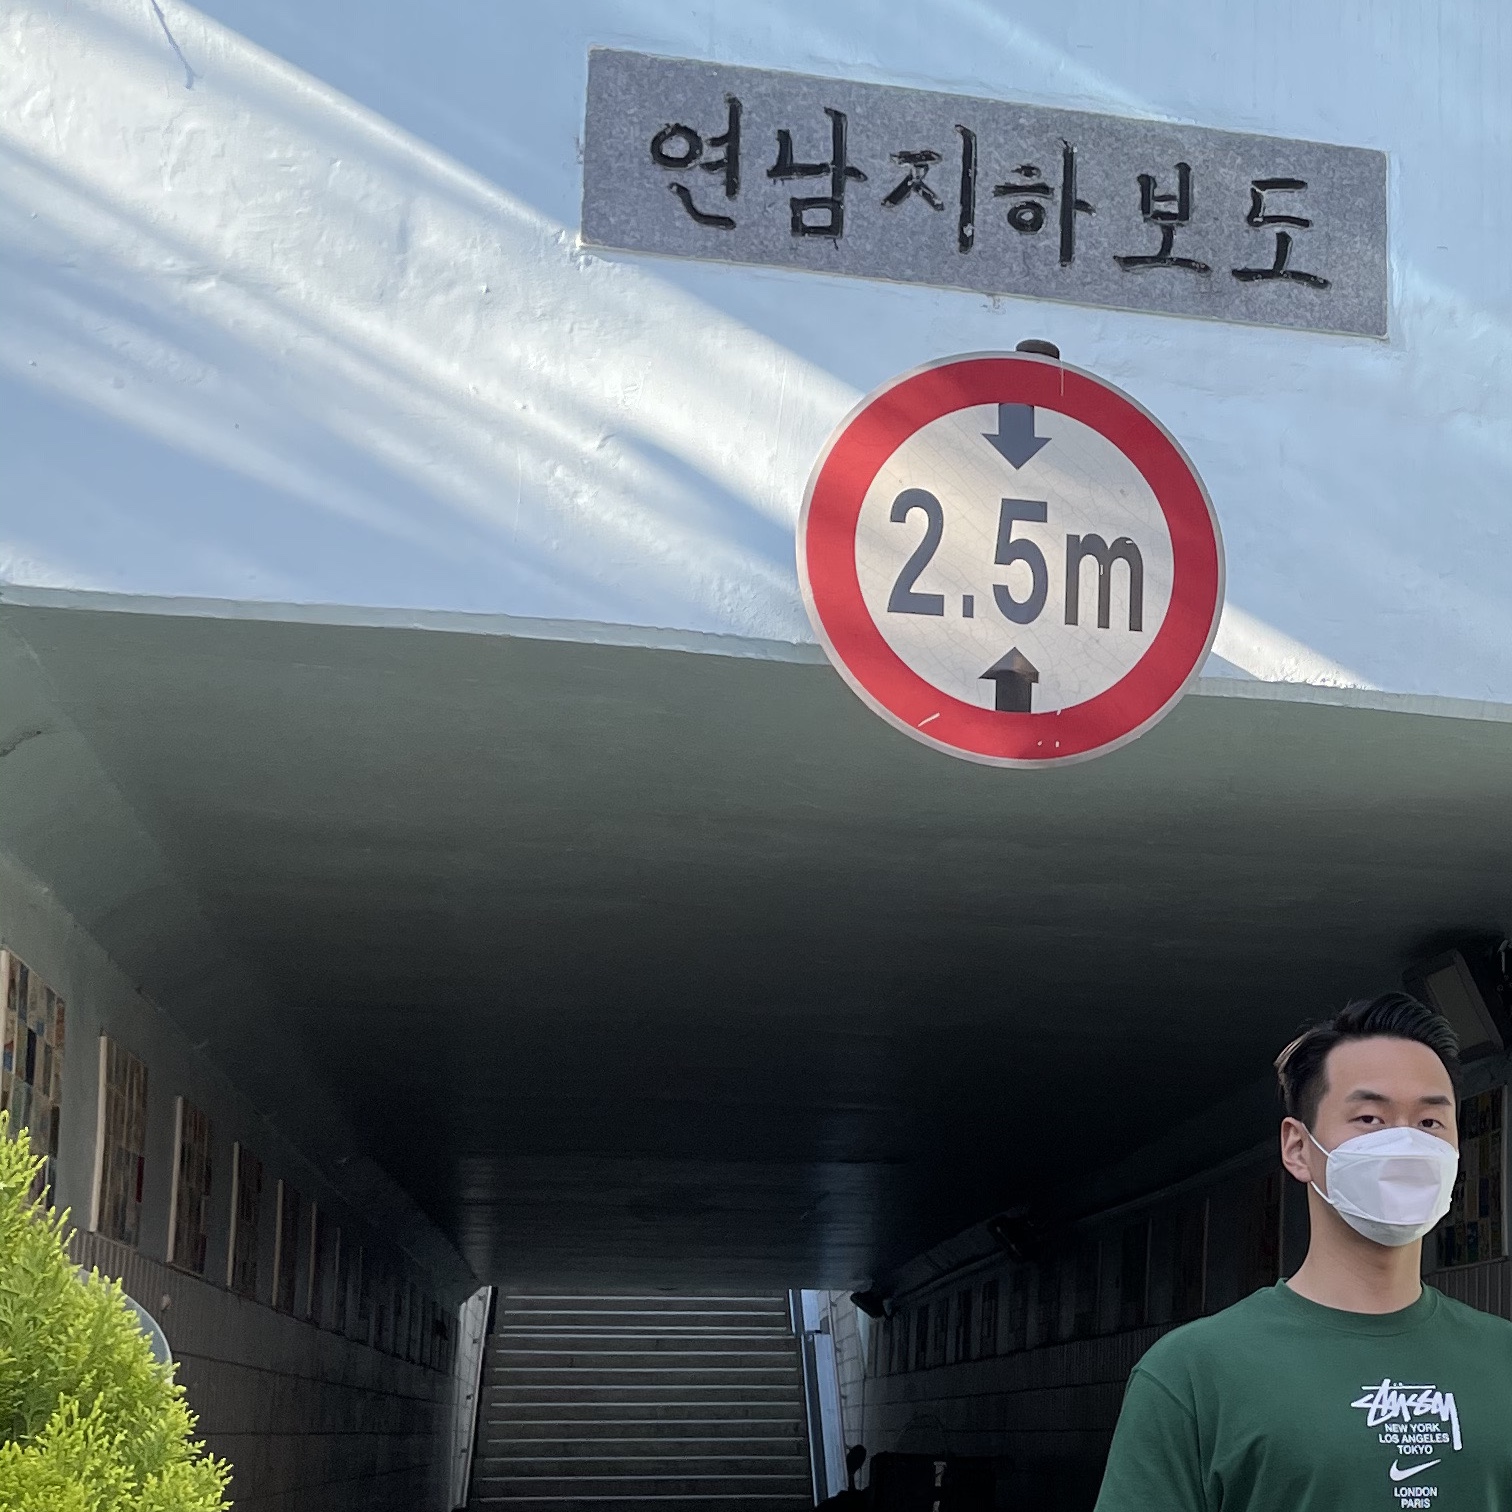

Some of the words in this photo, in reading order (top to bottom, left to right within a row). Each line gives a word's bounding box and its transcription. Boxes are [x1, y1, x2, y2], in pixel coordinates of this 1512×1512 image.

[649, 92, 1332, 291] 연남지하보도
[886, 488, 1145, 632] 2.5m
[1384, 1423, 1408, 1433] NEW
[1410, 1423, 1441, 1433] YORK
[1378, 1434, 1399, 1444] LOS
[1401, 1434, 1450, 1444] ANGELES
[1397, 1444, 1434, 1455] TOKYO
[1393, 1486, 1438, 1497] LONDON
[1400, 1498, 1431, 1509] PARIS
